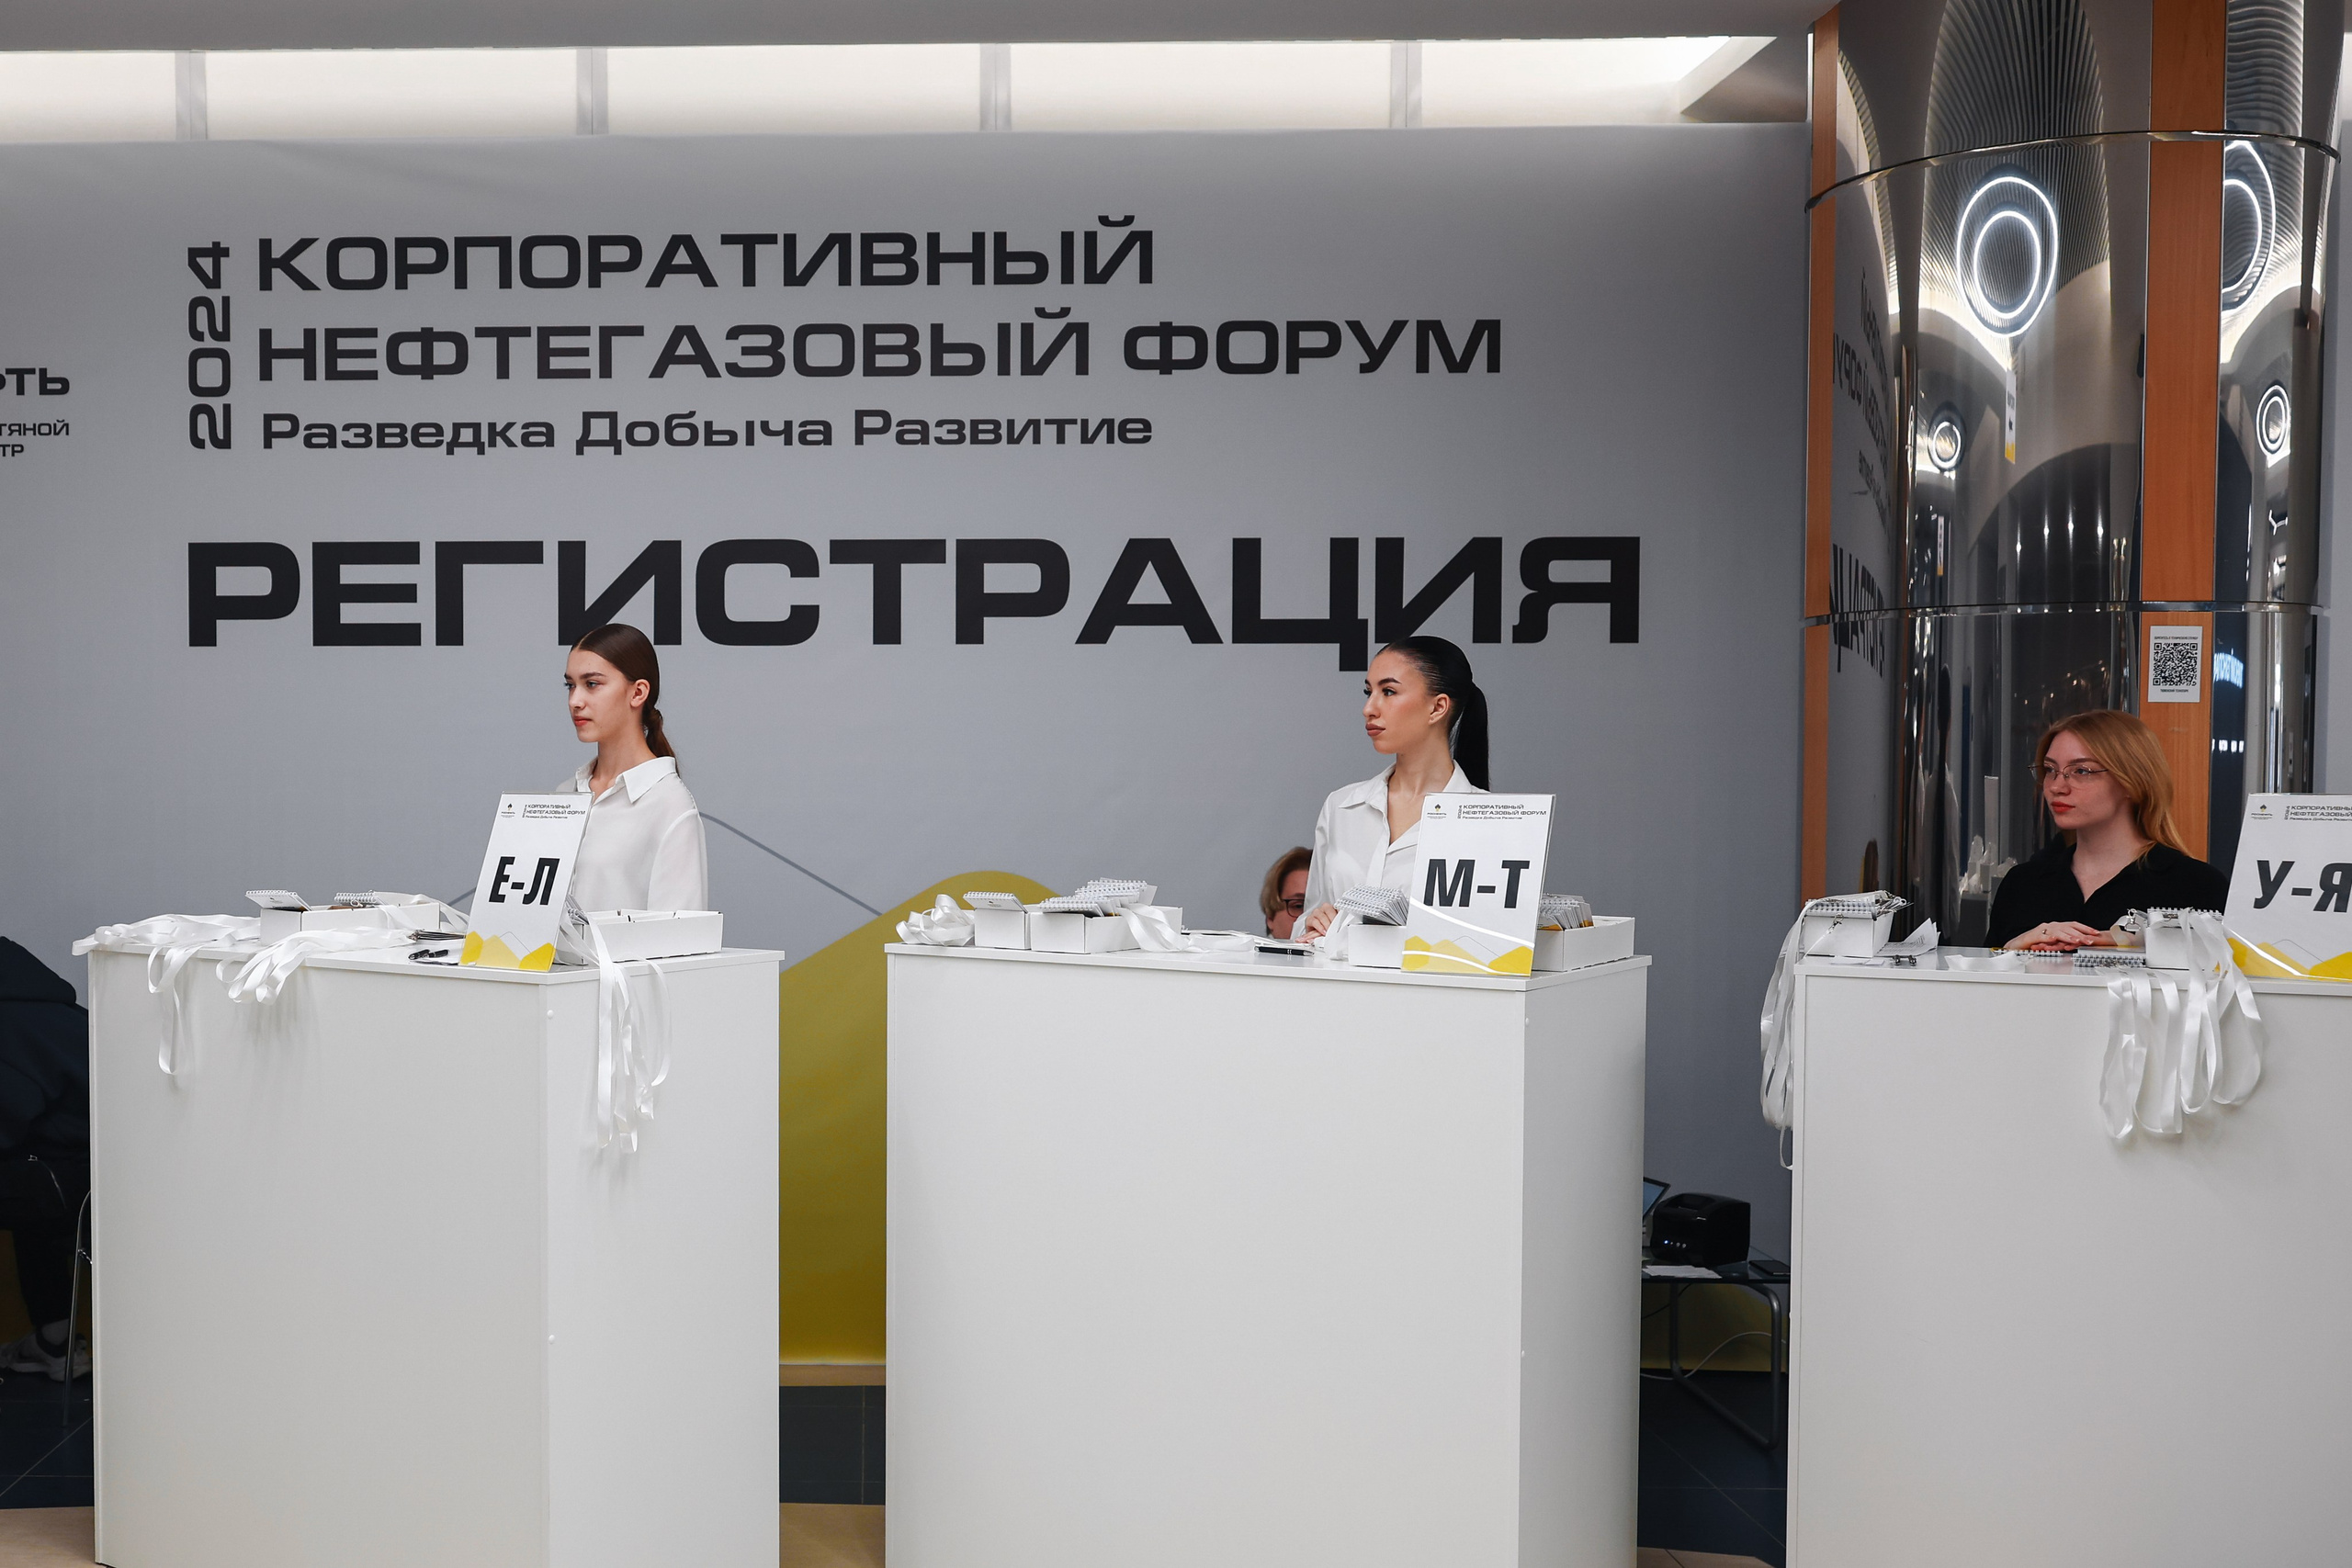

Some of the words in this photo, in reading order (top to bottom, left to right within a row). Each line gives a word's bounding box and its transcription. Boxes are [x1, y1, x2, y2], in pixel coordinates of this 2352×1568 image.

[259, 215, 1153, 291] КОРПОРАТИВНЫЙ
[187, 241, 232, 450] 2024
[259, 307, 1090, 382] НЕФТЕГАЗОВЫЙ
[1124, 319, 1501, 375] ФОРУМ
[0, 367, 70, 396] ТЬ
[264, 412, 555, 455] Разведка
[576, 411, 832, 456] Добыча
[855, 410, 1152, 446] Развитие
[188, 536, 1641, 671] РЕГИСТРАЦИЯ
[489, 857, 560, 905] Е-Л
[1423, 859, 1531, 908] М-Т
[2254, 860, 2352, 913] У-Я
